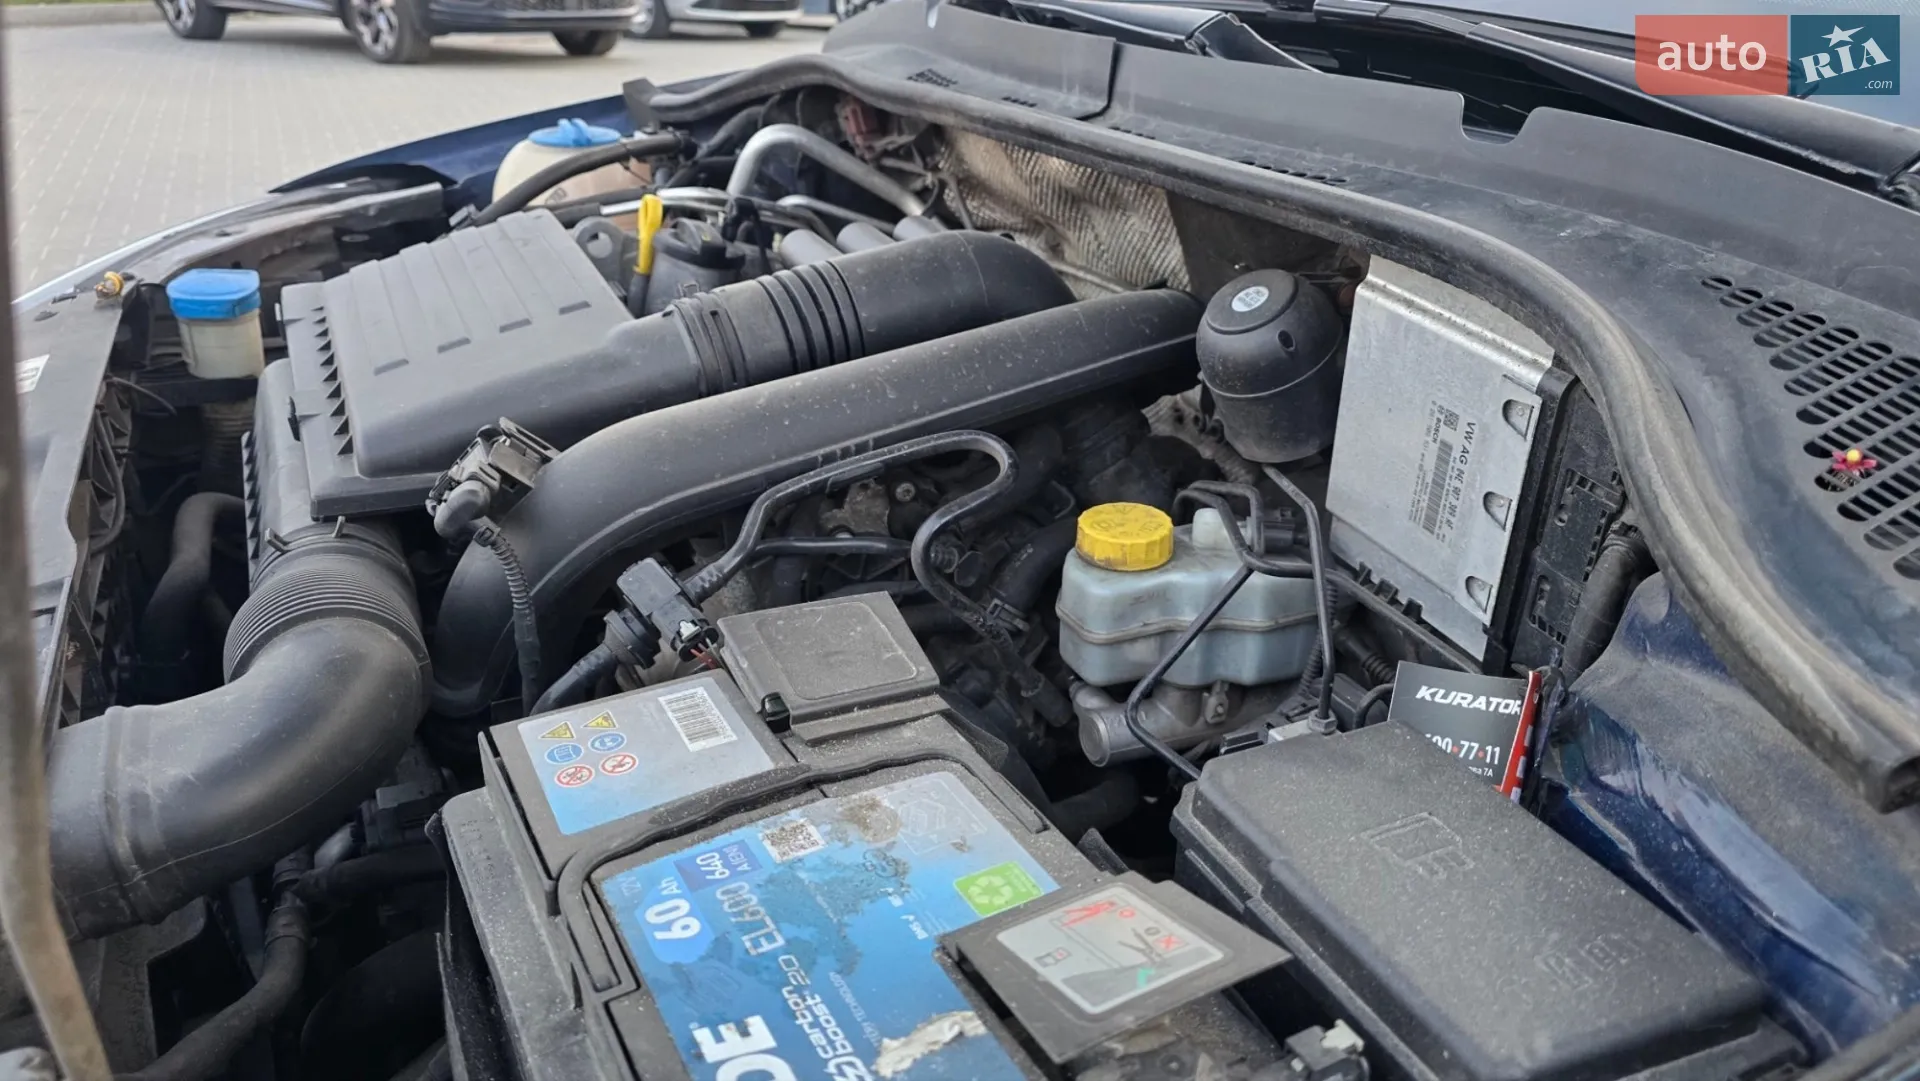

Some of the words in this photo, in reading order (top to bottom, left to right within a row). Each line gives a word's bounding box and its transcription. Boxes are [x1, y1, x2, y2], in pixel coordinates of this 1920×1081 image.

[1431, 416, 1442, 445] BOSCH
[1463, 421, 1477, 446] VW
[1458, 444, 1470, 466] AG
[1415, 685, 1522, 716] KURATOR
[695, 851, 731, 881] 640
[659, 876, 683, 897] Ah
[644, 898, 702, 941] 60
[715, 881, 787, 957] EL600
[781, 985, 835, 1061] carbon
[804, 992, 855, 1057] boost
